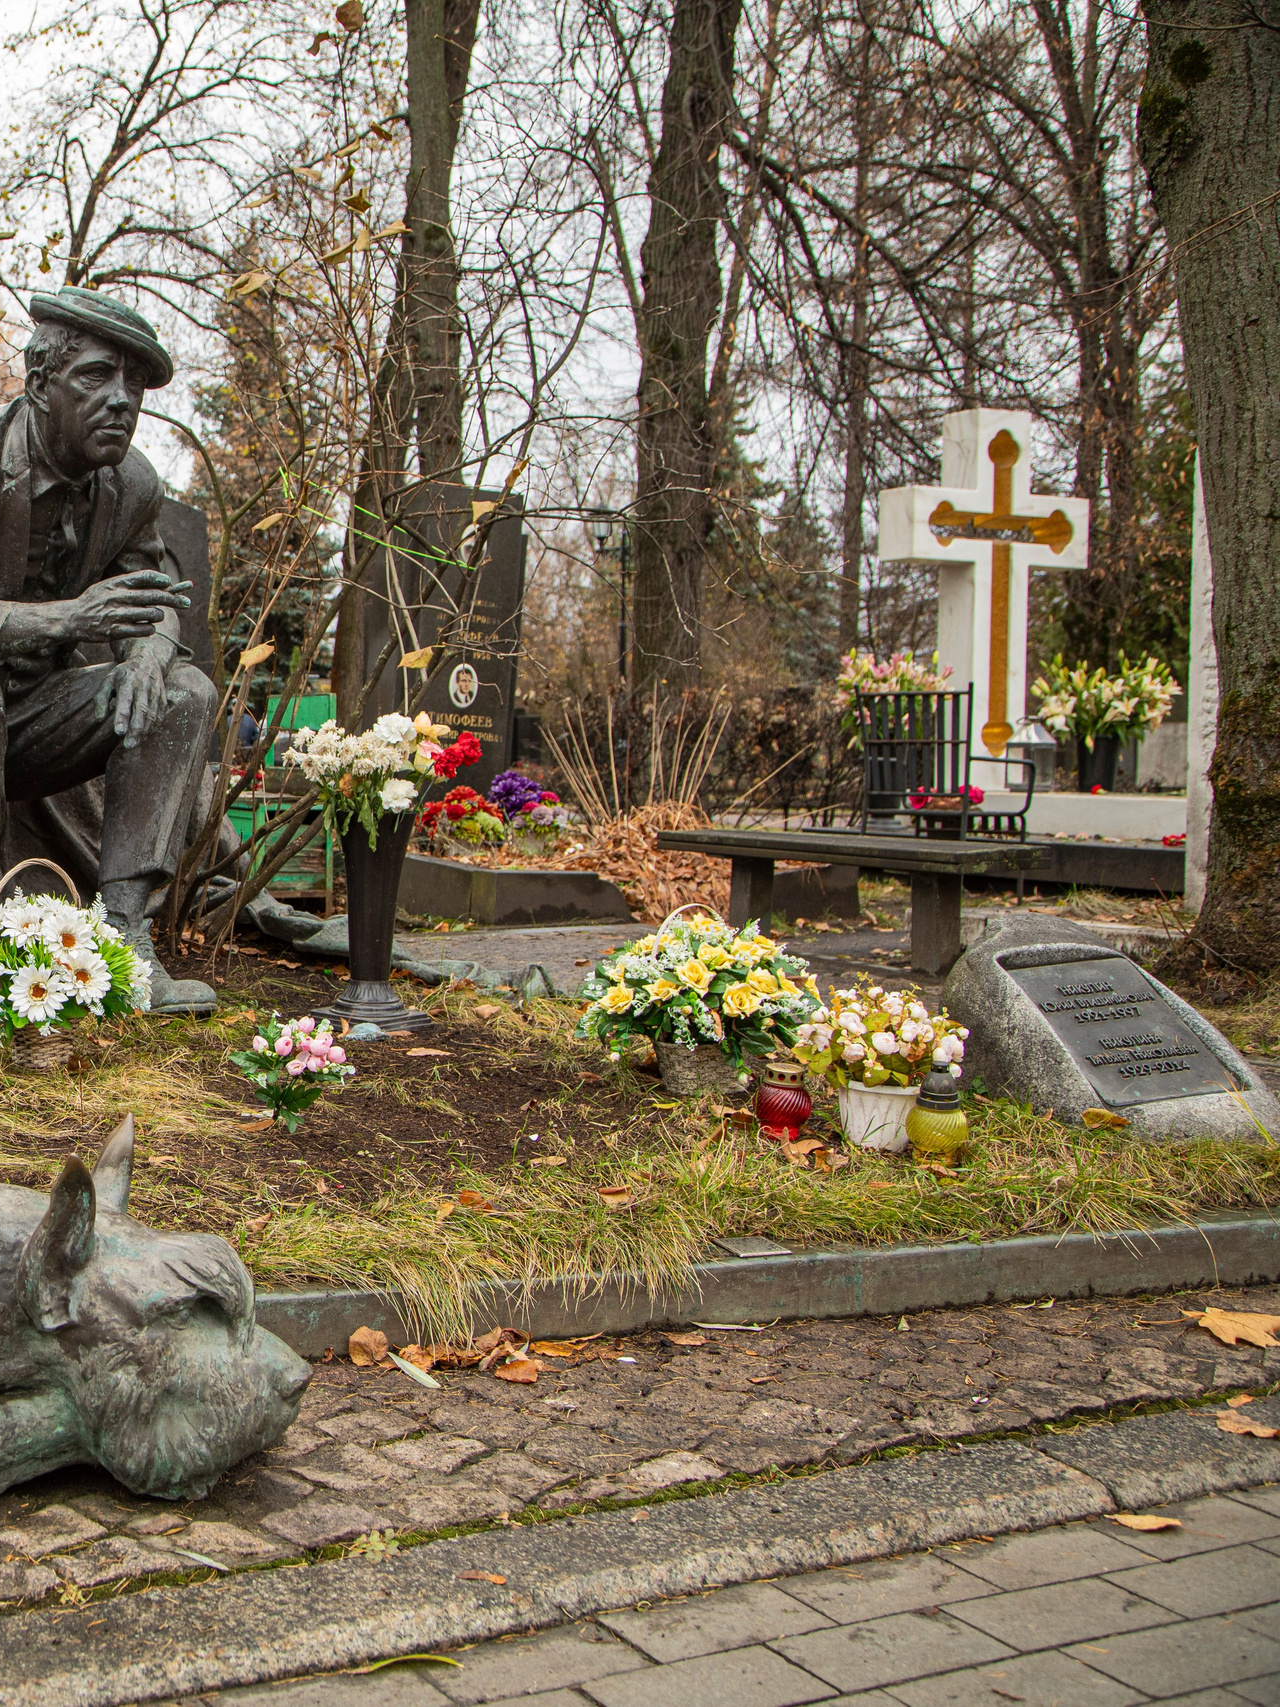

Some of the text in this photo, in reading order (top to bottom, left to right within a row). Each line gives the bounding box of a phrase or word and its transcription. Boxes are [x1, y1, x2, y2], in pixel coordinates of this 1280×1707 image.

[428, 711, 494, 728] ТИМОФЕЕВ
[1057, 980, 1114, 997] НИКУЛИН
[1039, 991, 1155, 1014] ЮРИЙ ВЛАДИМИРОВИЧ
[1074, 1006, 1141, 1024] 1921-1997
[1099, 1033, 1163, 1050] НИКУЛИНА
[1085, 1044, 1199, 1067] ТАТЬЯНА НИКОЛАЕВНА
[1118, 1060, 1190, 1079] 1929-2014
